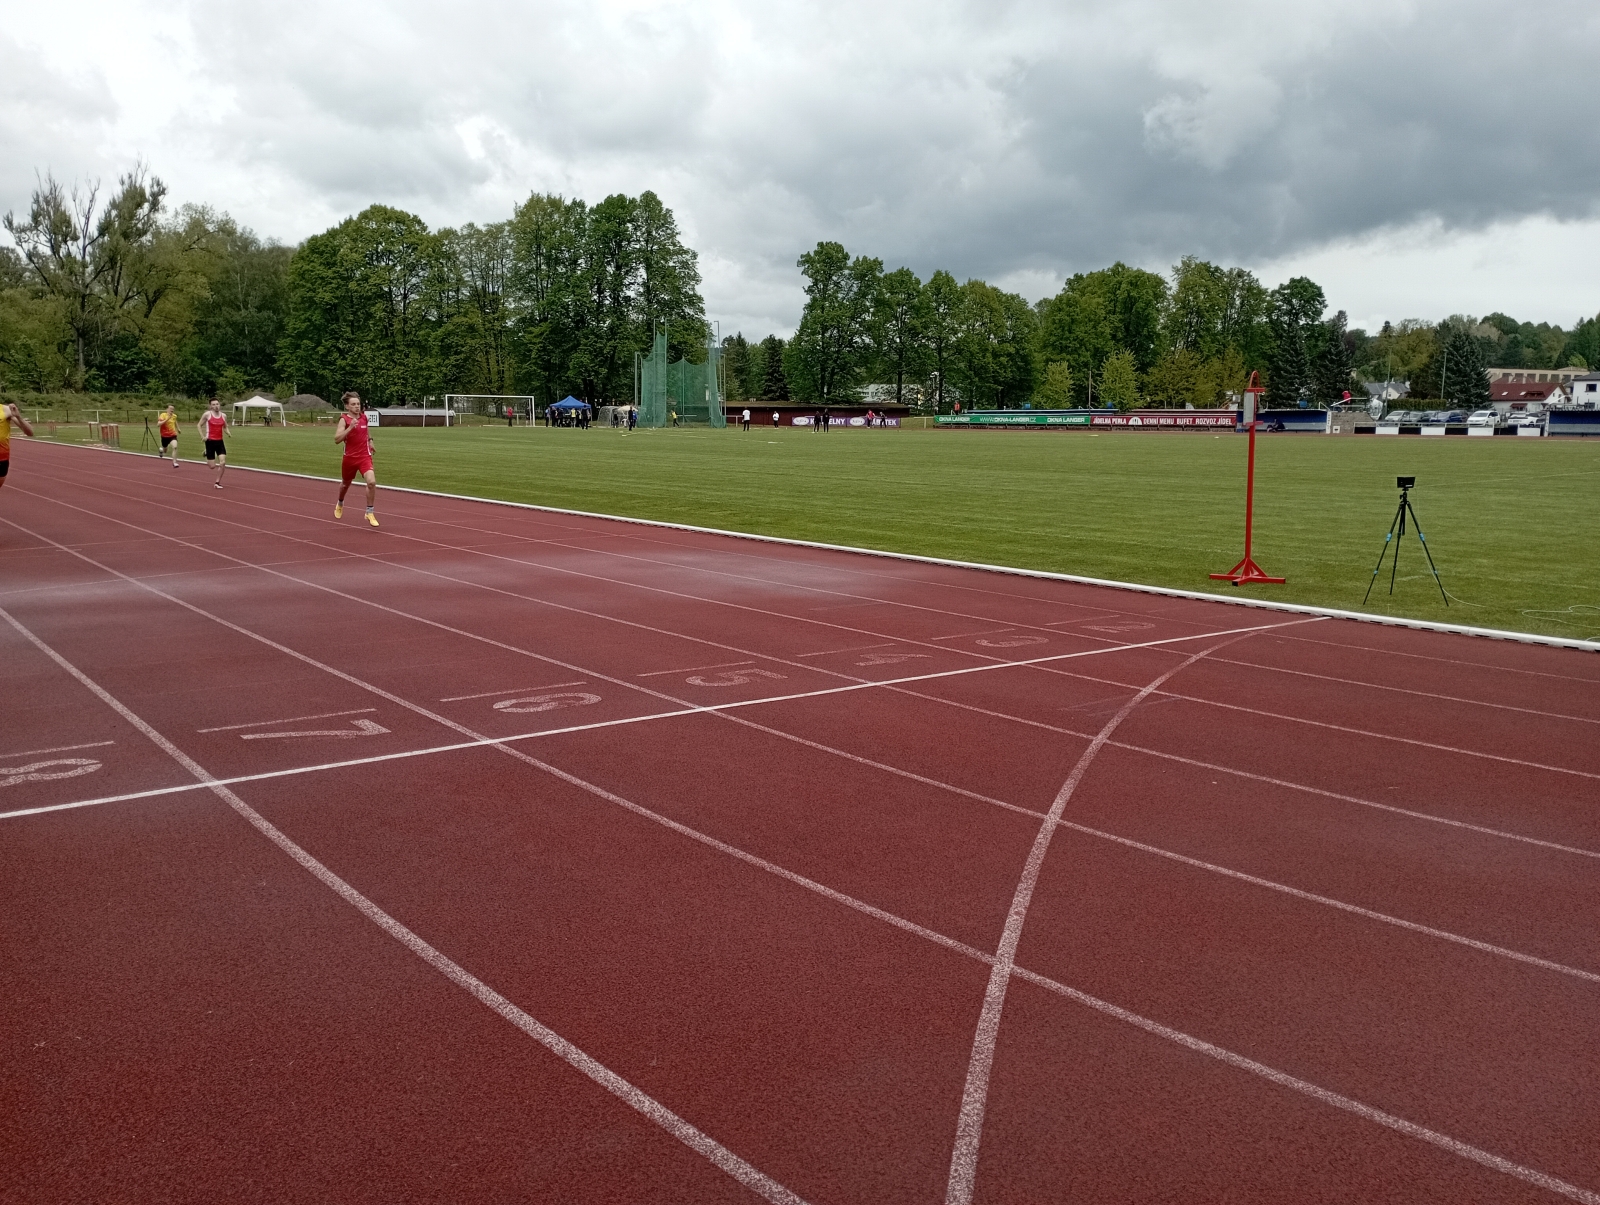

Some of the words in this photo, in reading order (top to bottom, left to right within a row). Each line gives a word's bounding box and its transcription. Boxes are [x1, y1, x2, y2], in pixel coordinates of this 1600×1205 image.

[975, 635, 1050, 647] 3
[686, 668, 788, 687] 5
[493, 692, 602, 713] 6
